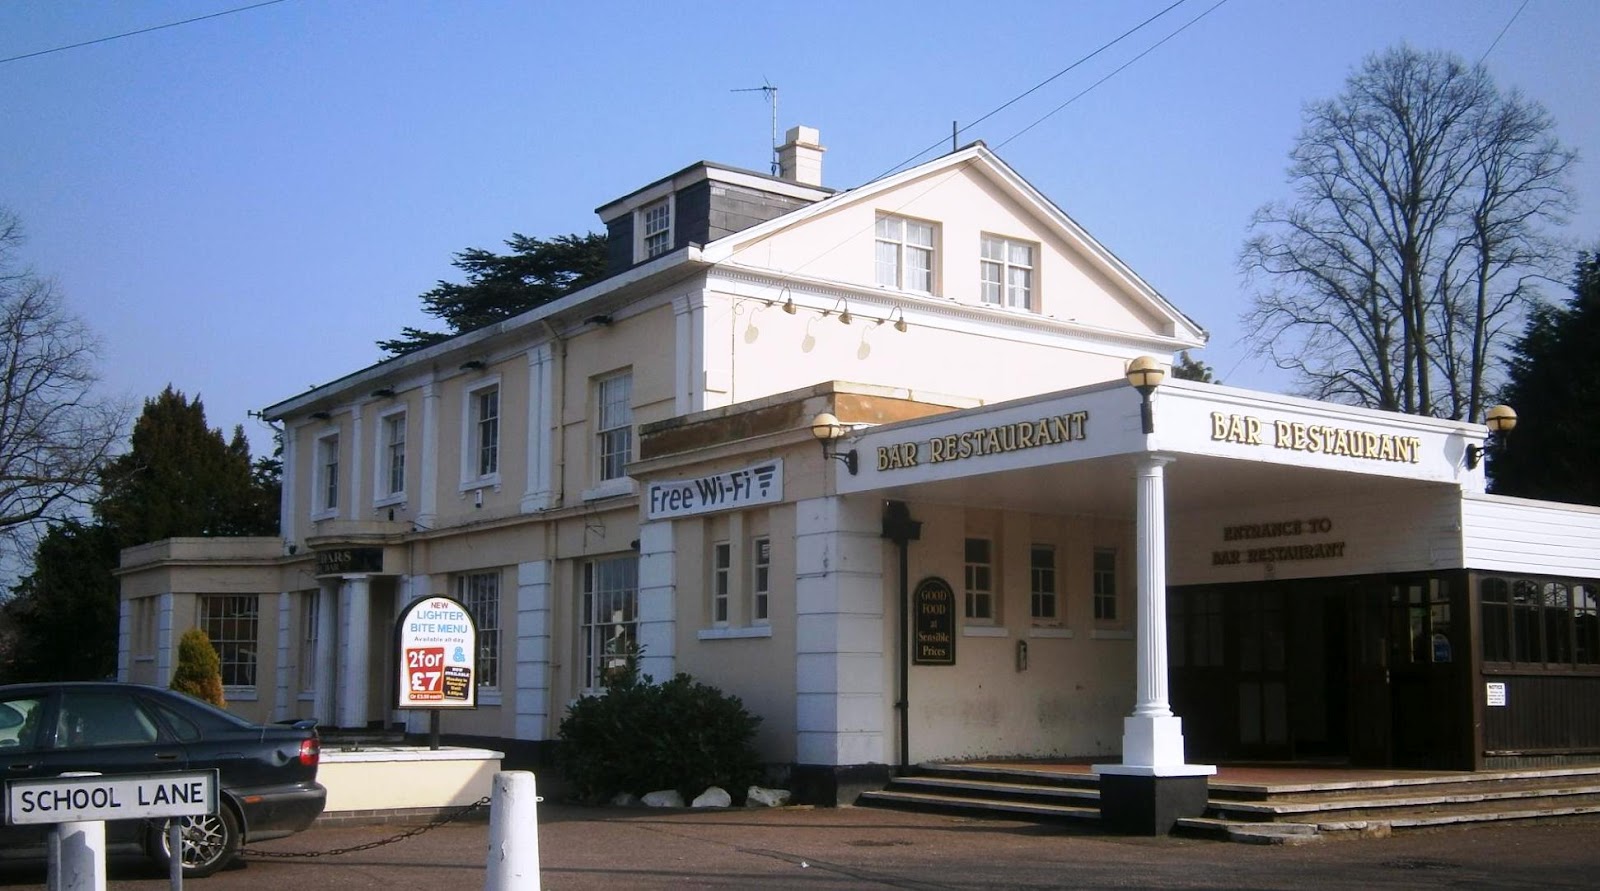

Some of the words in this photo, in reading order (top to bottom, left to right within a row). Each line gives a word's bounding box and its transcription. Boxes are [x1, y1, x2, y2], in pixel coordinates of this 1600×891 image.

[877, 442, 918, 471] BAR
[929, 411, 1088, 463] RESTAURANT
[1211, 411, 1262, 444] BAR
[1275, 420, 1421, 463] RESTAURANT
[651, 485, 694, 513] Free
[695, 471, 751, 506] Wi-Fi
[1223, 520, 1302, 541] ENTRANCE
[1308, 518, 1332, 534] TO
[1212, 550, 1241, 565] BAR
[1248, 541, 1345, 563] RESTAURANT
[922, 591, 947, 600] GOOD
[417, 610, 464, 620] LIGHTER
[922, 603, 946, 614] FOOD
[410, 623, 435, 632] BITE
[437, 624, 468, 633] MENU
[930, 620, 937, 628] at
[918, 631, 949, 642] Sensible
[453, 646, 466, 662] &
[922, 645, 946, 656] Prices
[411, 672, 441, 691] £7
[22, 787, 121, 813] SCHOOL
[138, 782, 204, 806] LANE
